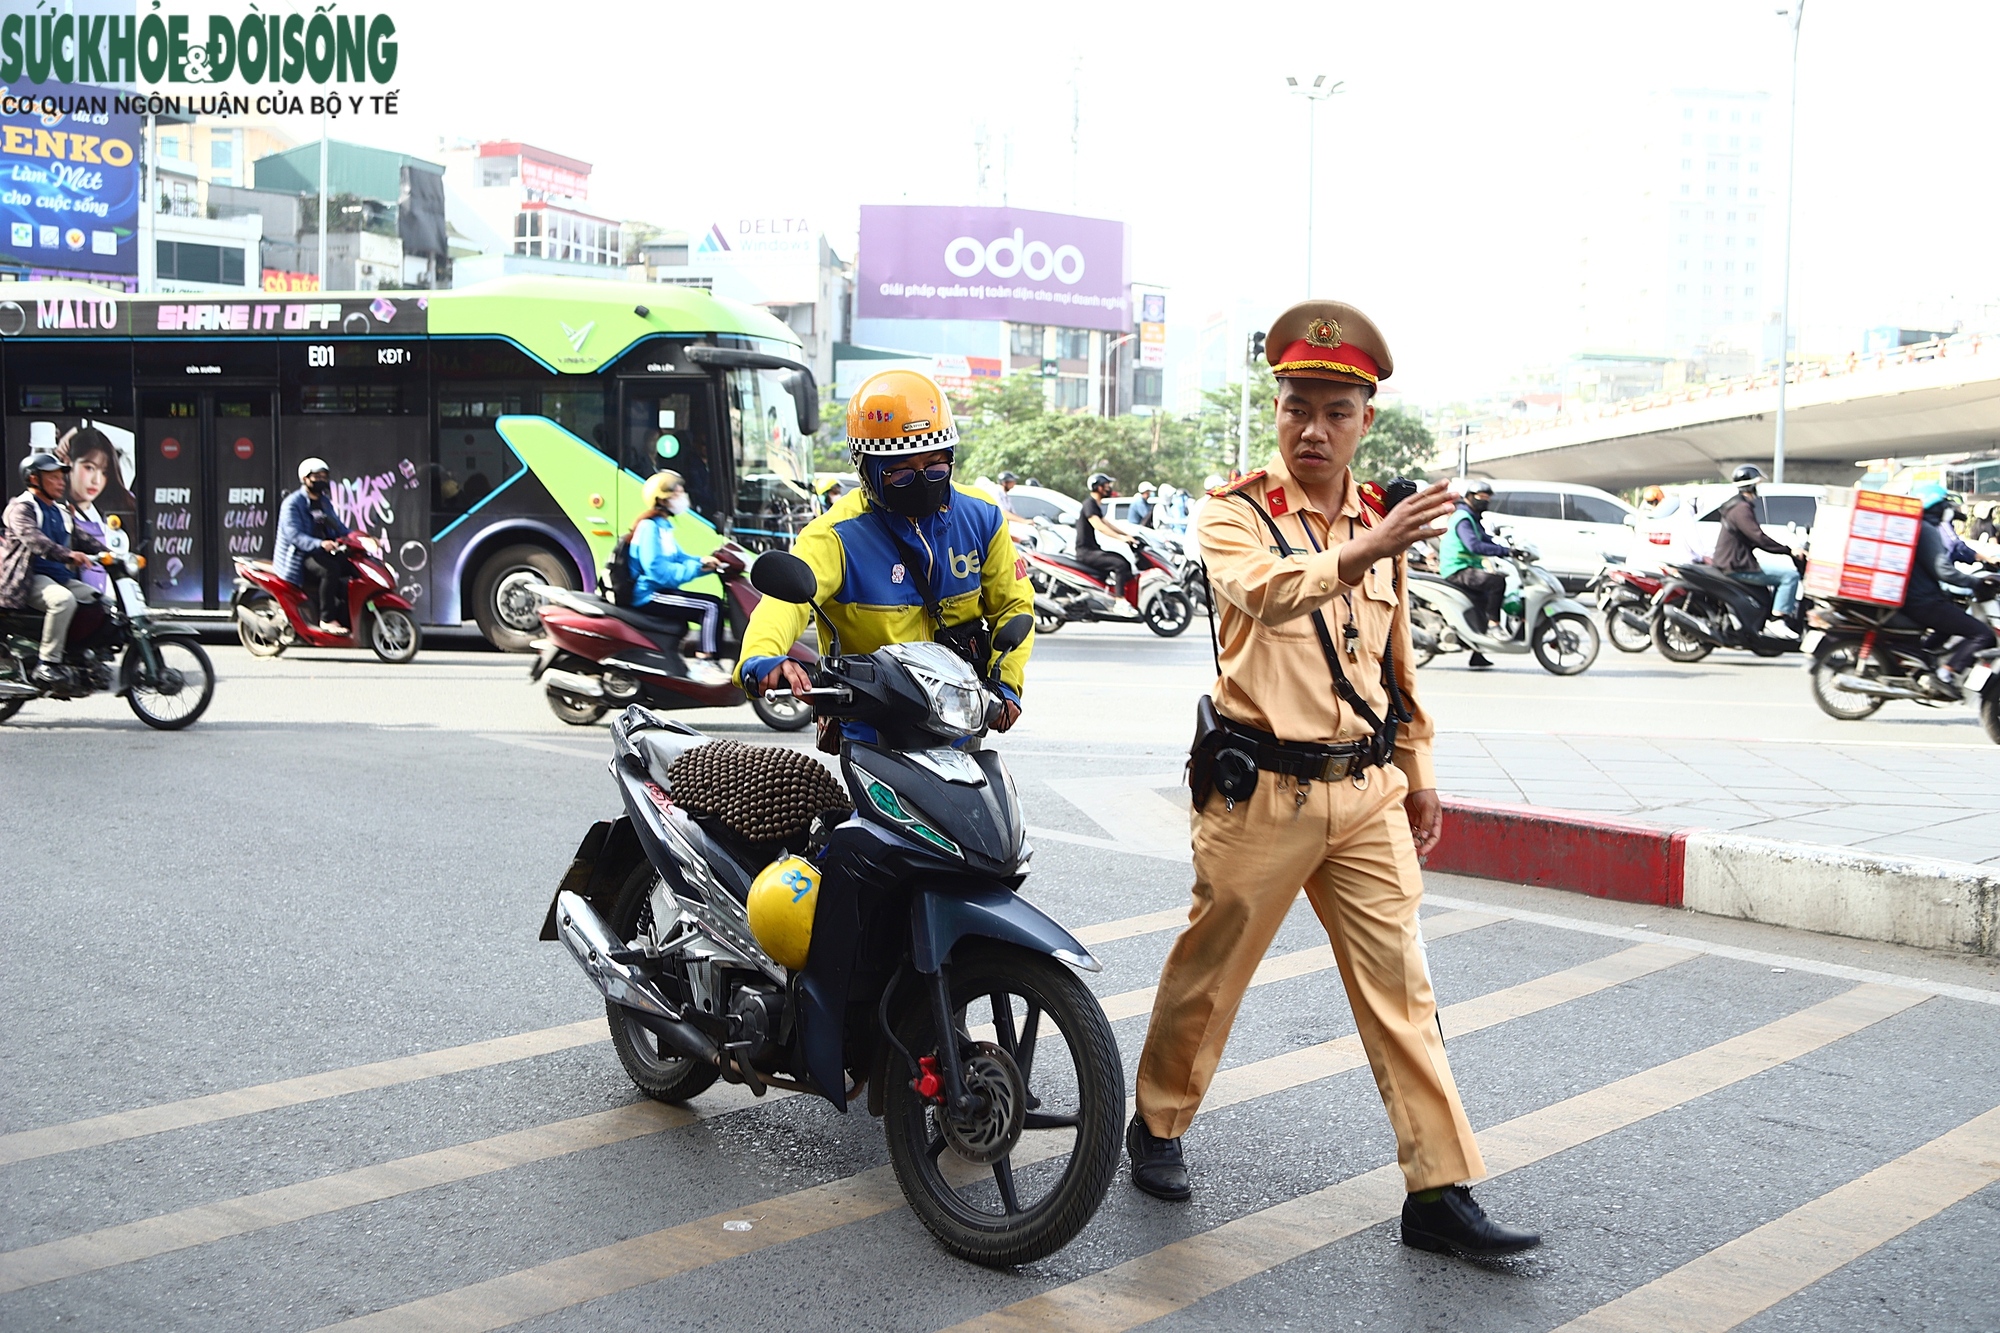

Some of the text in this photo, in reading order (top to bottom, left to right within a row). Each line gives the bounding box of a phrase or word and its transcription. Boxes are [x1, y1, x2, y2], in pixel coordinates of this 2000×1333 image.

[0, 125, 134, 168] ENKO
[11, 164, 48, 183] Làm
[2, 189, 109, 218] cho cuộc sống
[739, 218, 809, 234] DELTA
[739, 239, 810, 252] Windows
[944, 227, 1085, 285] odoo
[905, 284, 936, 298] pháp
[969, 285, 984, 299] trị
[985, 285, 1012, 298] toàn
[1035, 289, 1052, 302] cho
[157, 304, 341, 330] SHAKE IT OFF
[308, 345, 335, 367] E01
[948, 547, 981, 579] be
